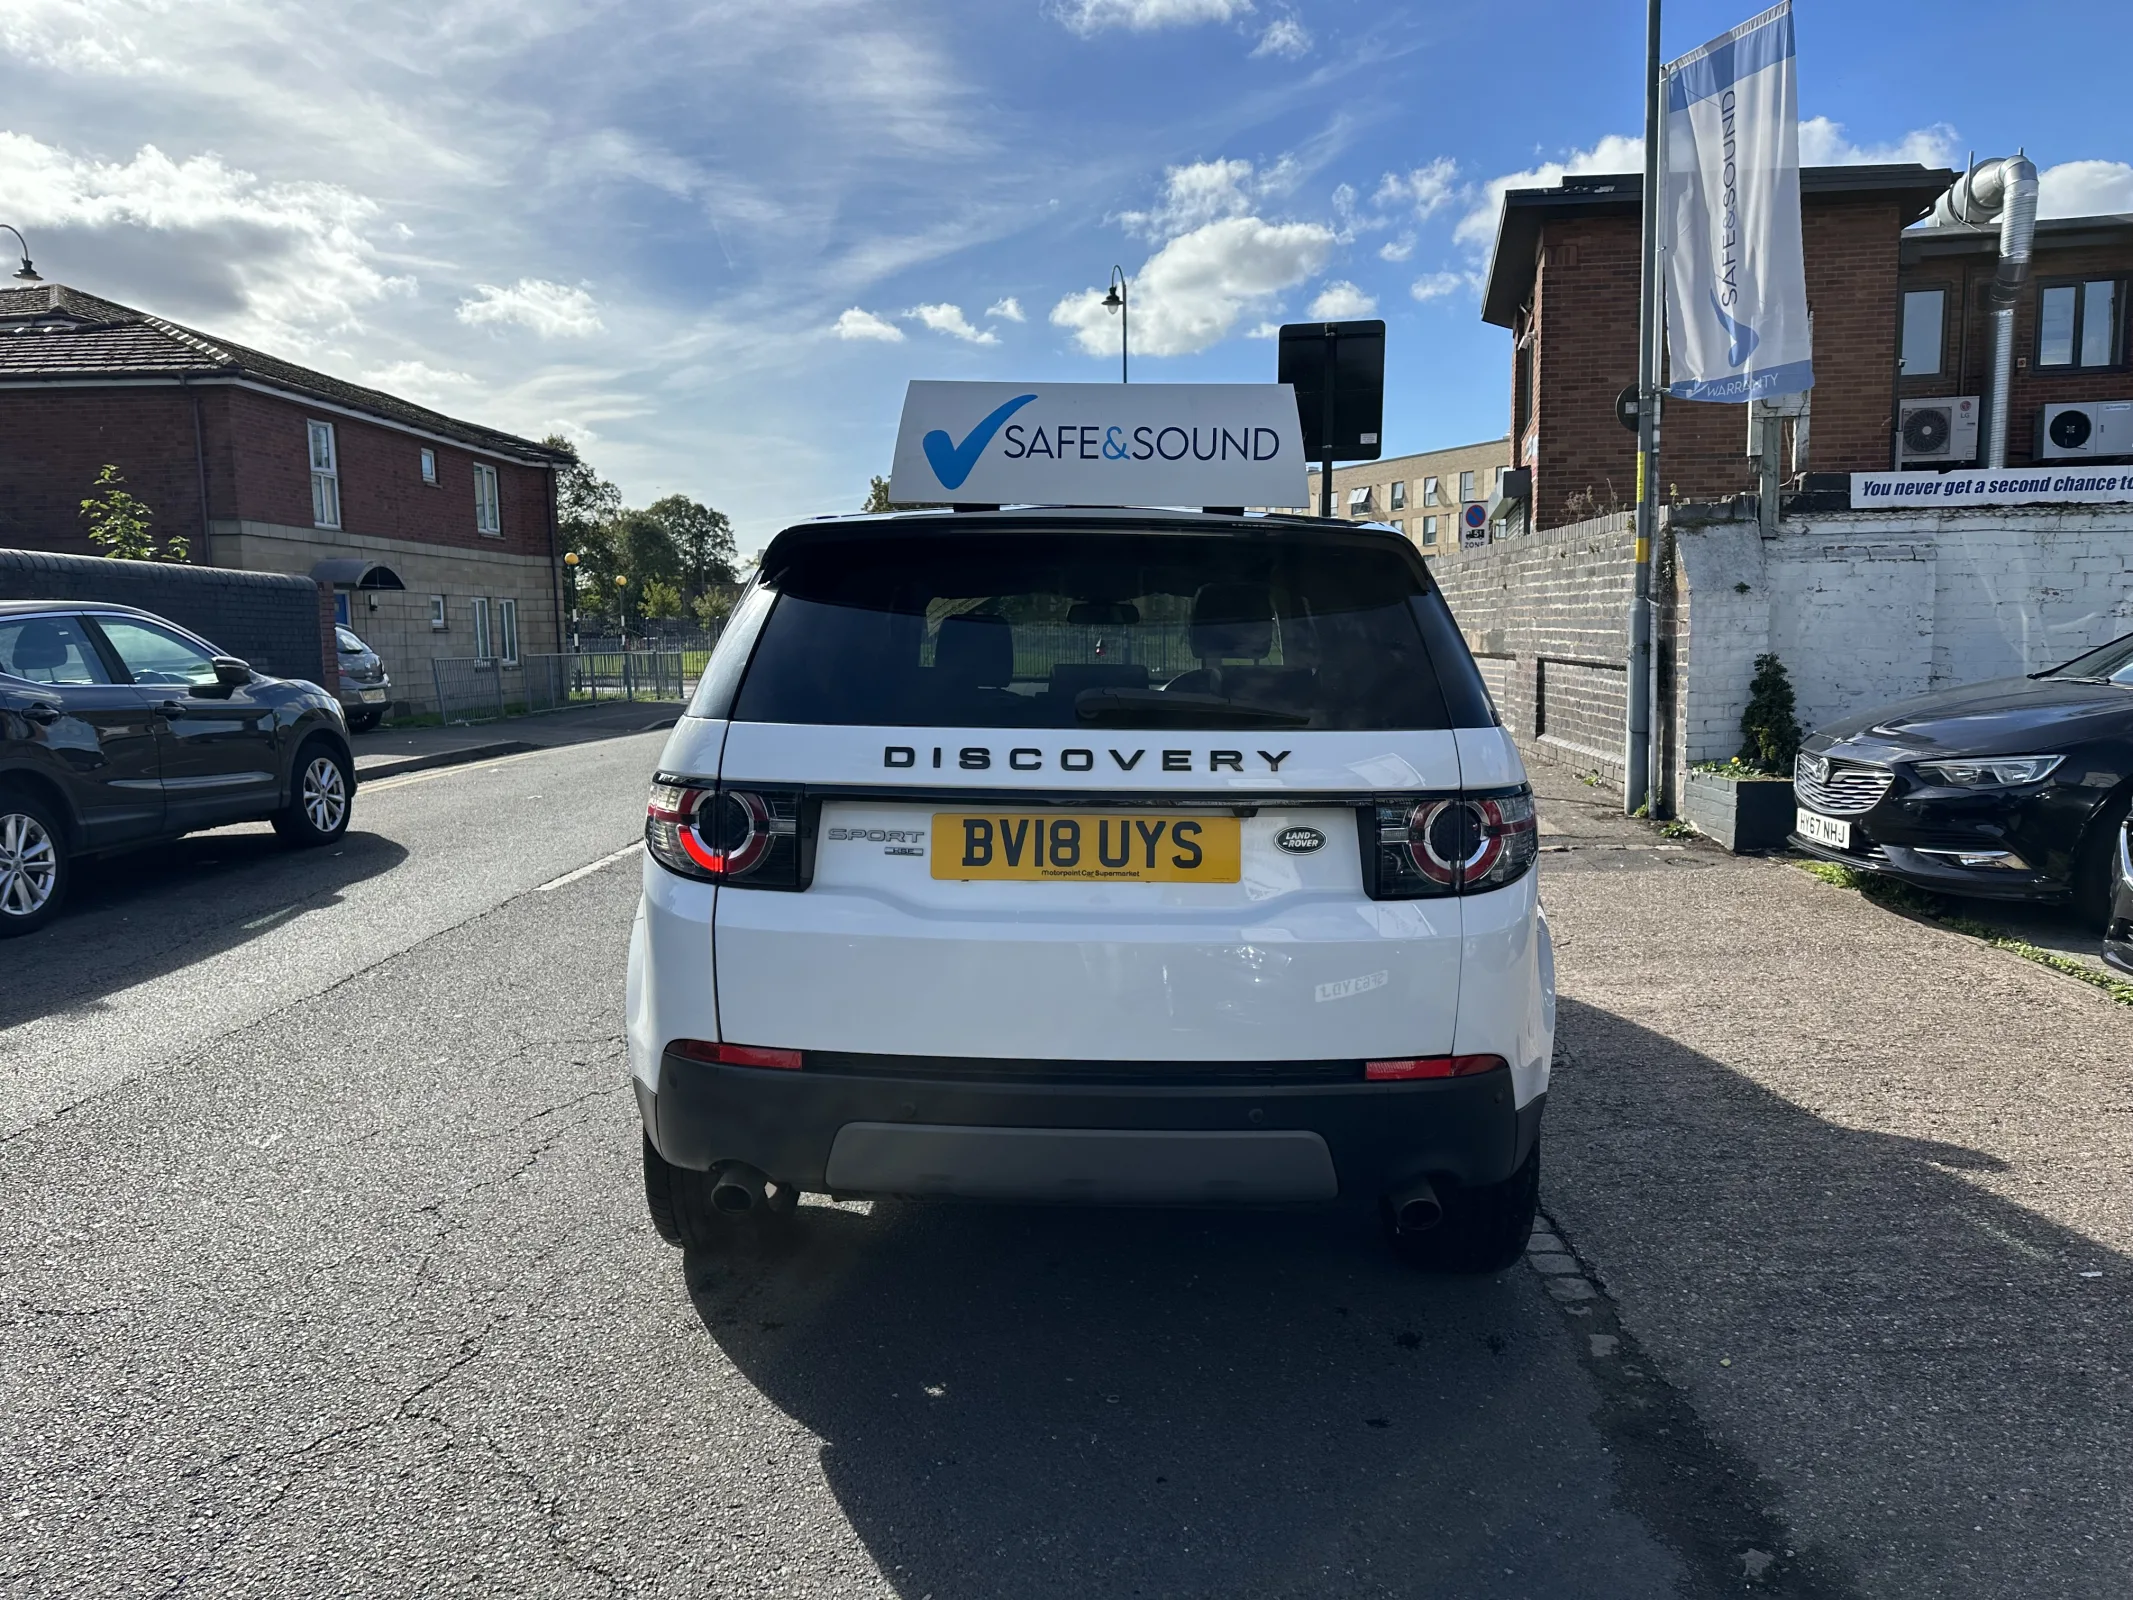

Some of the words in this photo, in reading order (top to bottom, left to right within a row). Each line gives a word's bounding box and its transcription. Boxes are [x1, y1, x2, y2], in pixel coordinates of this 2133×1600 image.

[1721, 90, 1737, 307] SAFE&SOUND
[1707, 373, 1778, 397] WARRANTY
[1003, 424, 1280, 461] SAFE&SOUND
[1863, 481, 1892, 496] You
[1894, 481, 1941, 495] never
[1943, 480, 1973, 496] get
[1974, 480, 1986, 493] a
[1988, 476, 2052, 493] second
[2053, 476, 2116, 491] chance
[884, 746, 1292, 772] DISCOVERY
[828, 828, 925, 843] SPORT
[1285, 832, 1311, 840] LAND
[1800, 812, 1821, 836] HY67
[1823, 820, 1845, 844] NHJ
[962, 818, 1081, 868] BV18
[1099, 820, 1204, 869] UYS
[1288, 839, 1319, 848] ROVER
[1081, 869, 1095, 877] Car
[1095, 869, 1140, 878] Supermarket
